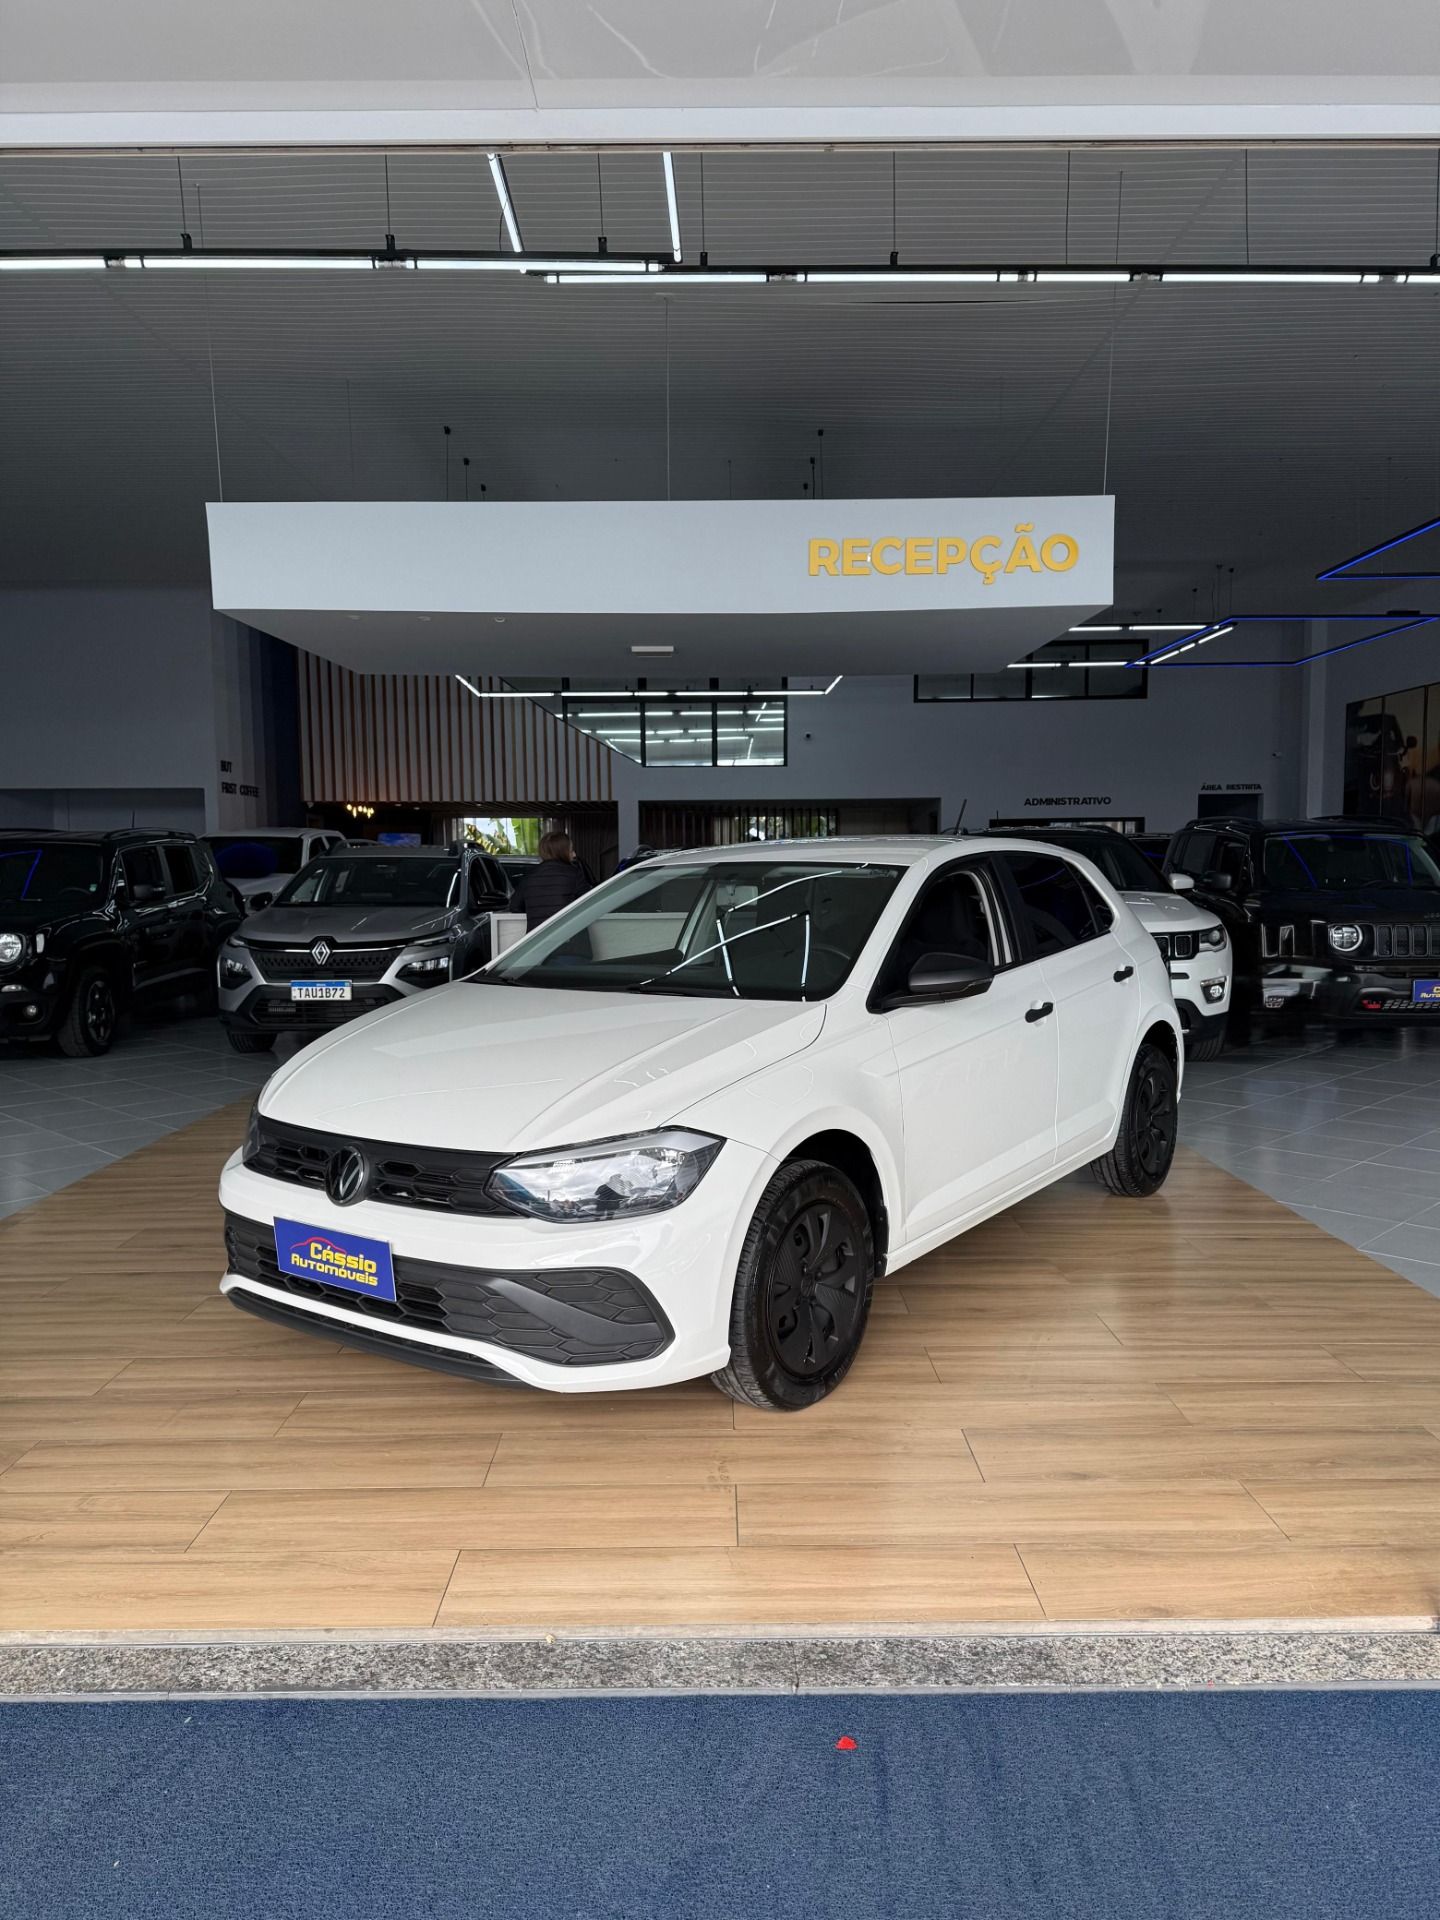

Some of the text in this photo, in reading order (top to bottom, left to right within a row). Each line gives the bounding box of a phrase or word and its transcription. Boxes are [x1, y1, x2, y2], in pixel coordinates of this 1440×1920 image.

[807, 522, 1080, 585] RECEPÇÃO
[1023, 796, 1112, 806] ADMINISTRATIVO
[297, 987, 346, 999] TAU1B72
